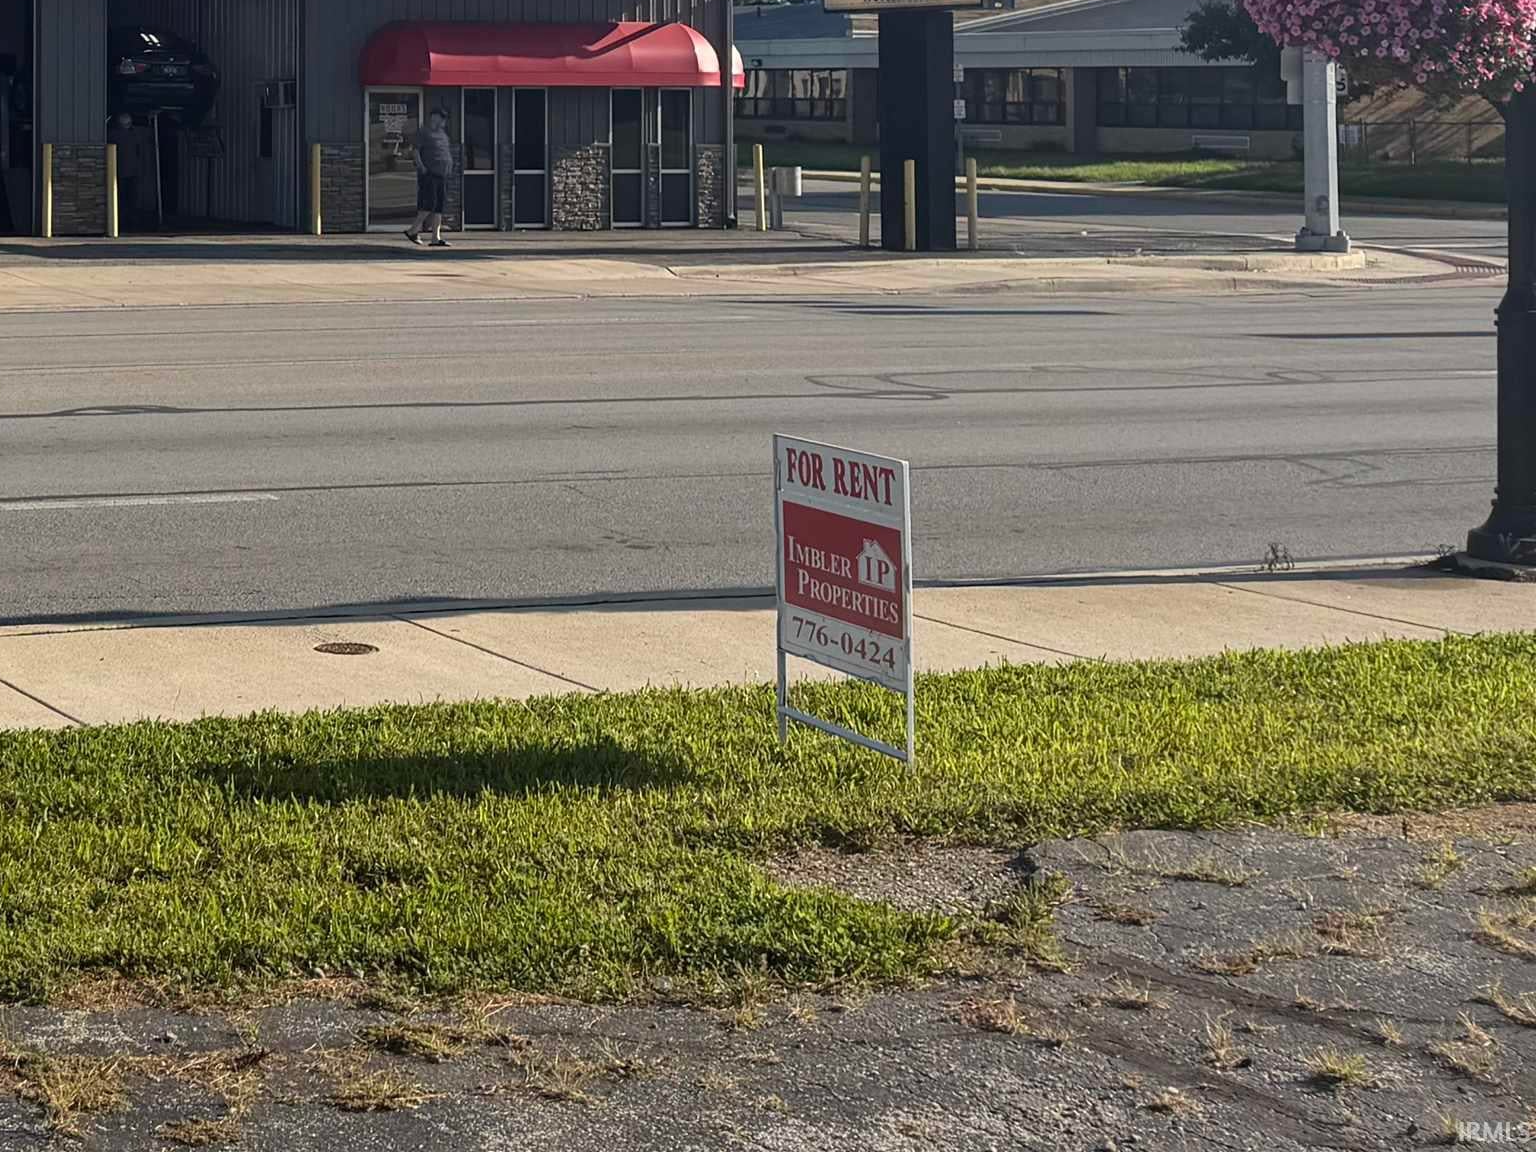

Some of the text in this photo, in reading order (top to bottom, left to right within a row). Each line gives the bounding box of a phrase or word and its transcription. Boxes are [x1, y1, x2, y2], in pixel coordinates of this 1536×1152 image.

[786, 447, 896, 506] FOR RENT
[787, 535, 852, 579] IMBLER
[797, 567, 898, 624] PROPERTIES
[792, 615, 896, 672] 776-0424
